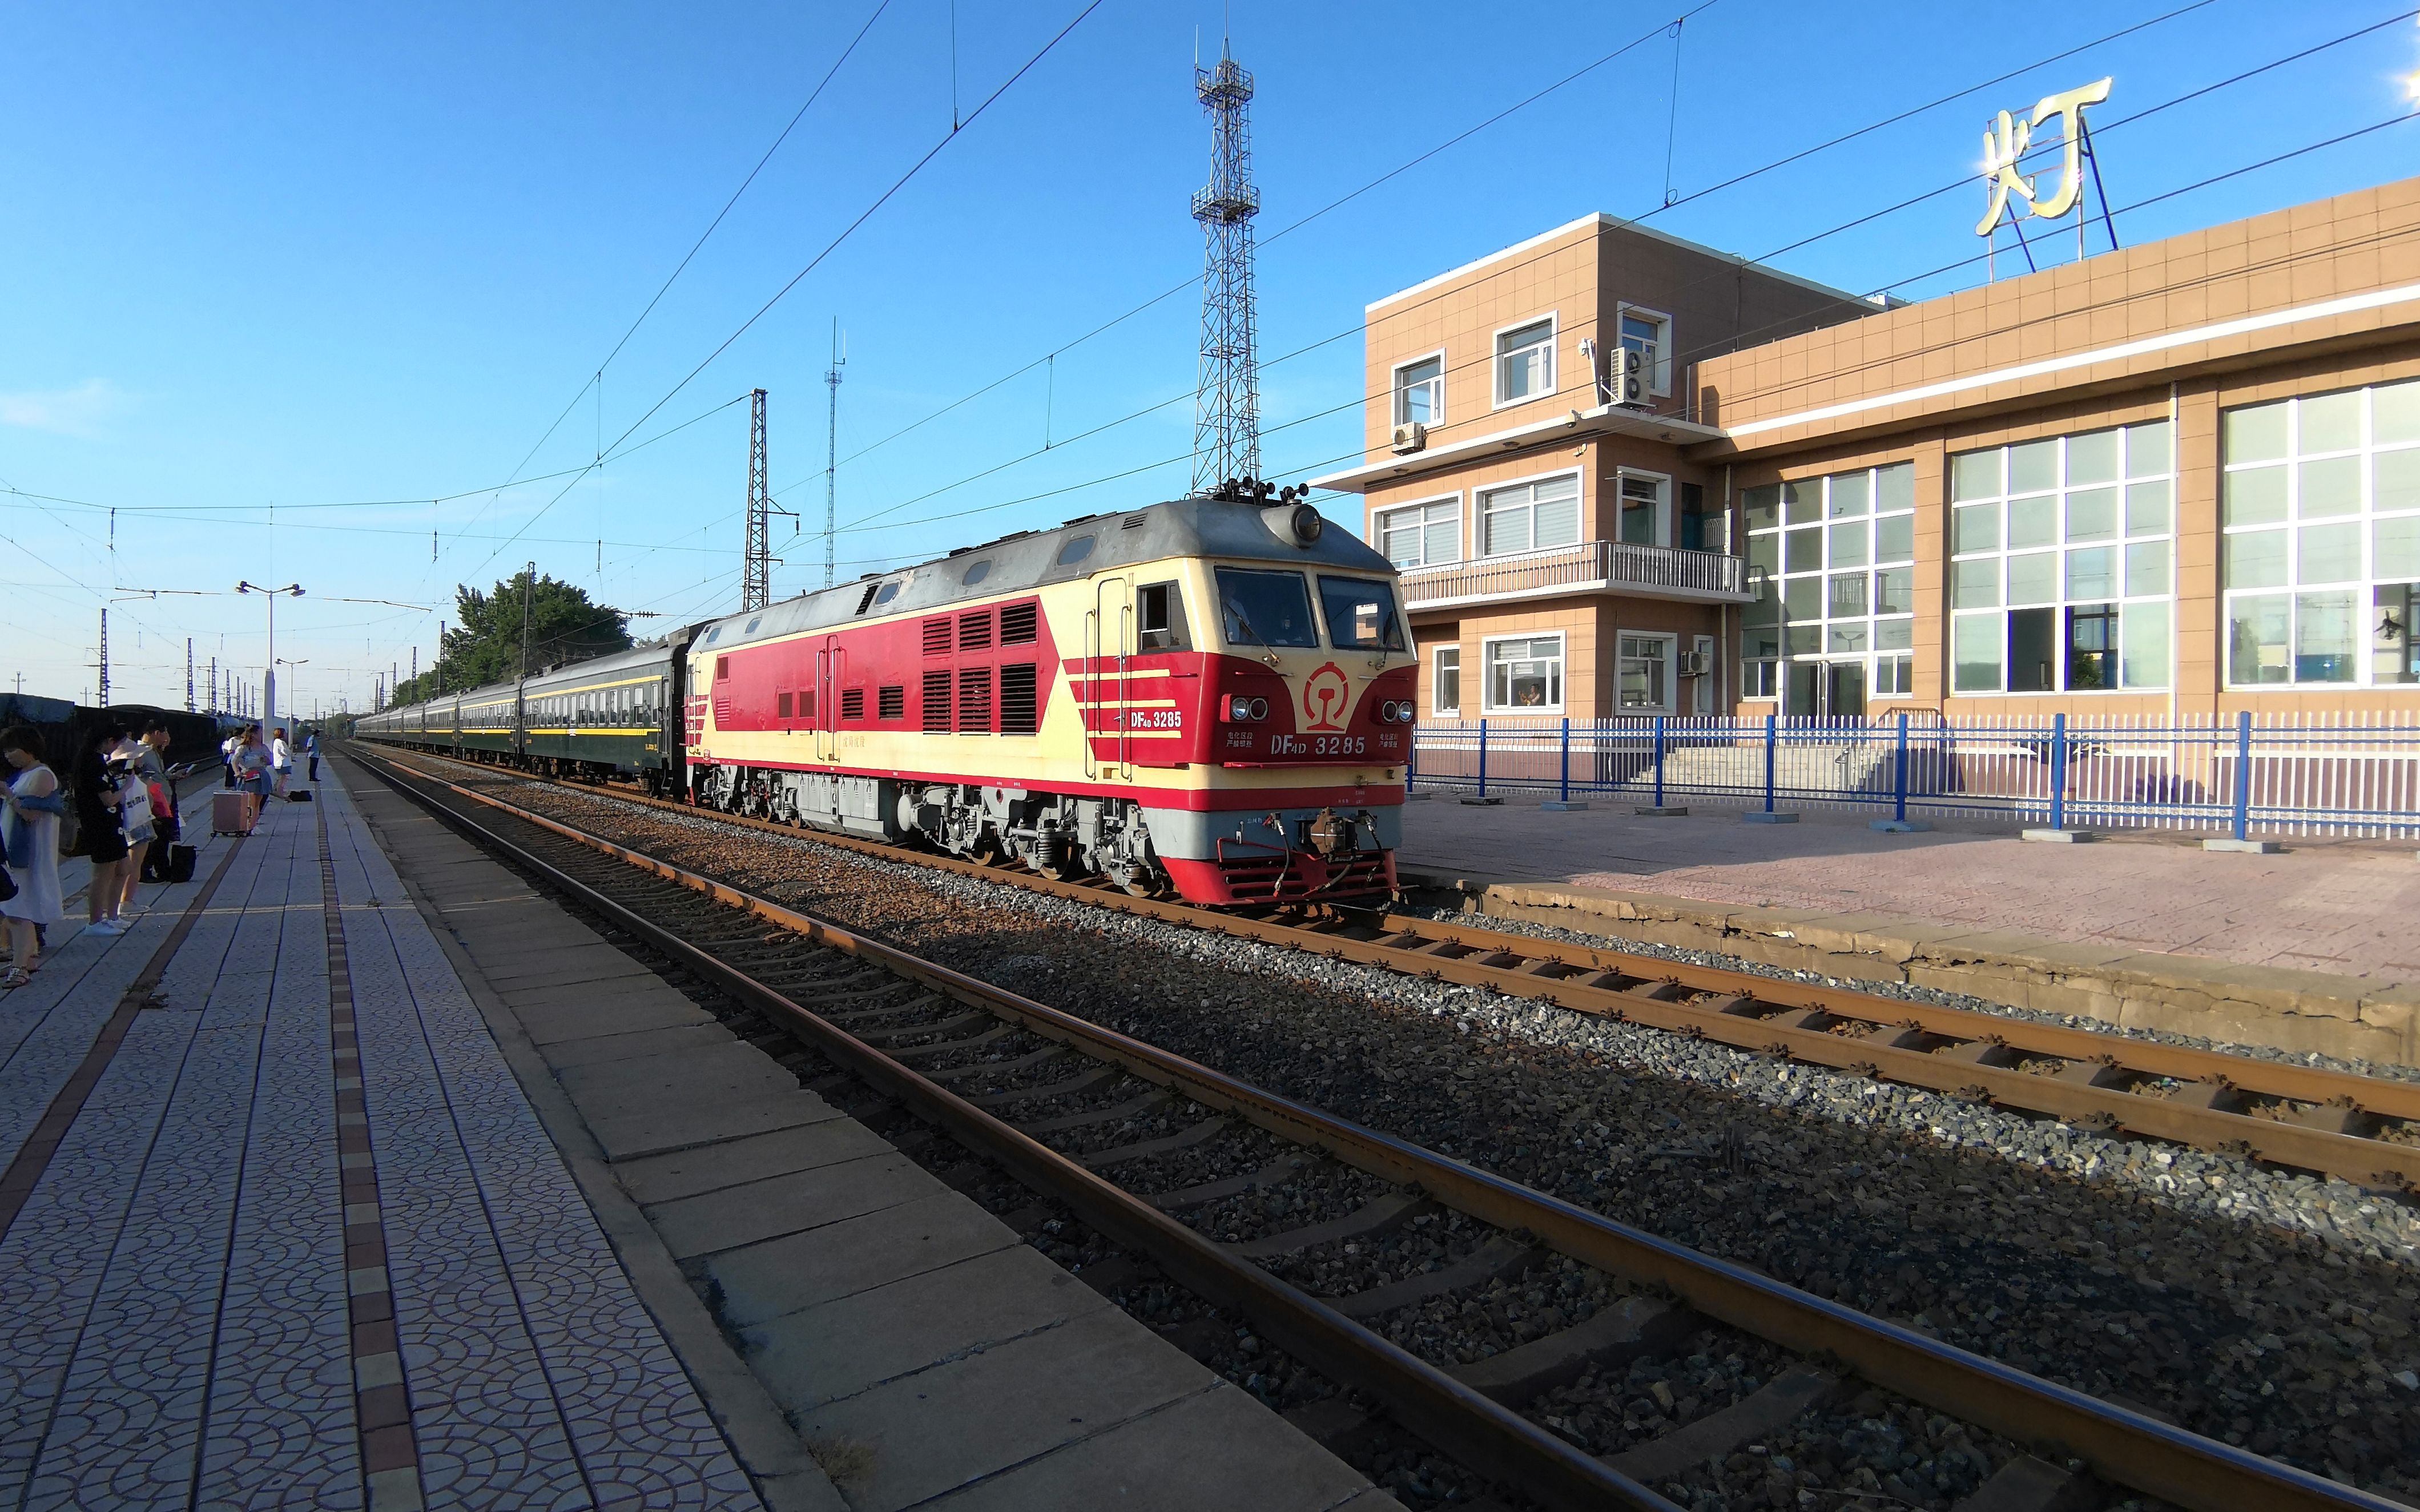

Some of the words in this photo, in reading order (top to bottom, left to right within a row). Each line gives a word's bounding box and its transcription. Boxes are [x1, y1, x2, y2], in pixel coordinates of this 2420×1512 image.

[1975, 76, 2113, 237] 灯
[1153, 711, 1181, 727] 3285
[1315, 736, 1365, 755] 3285
